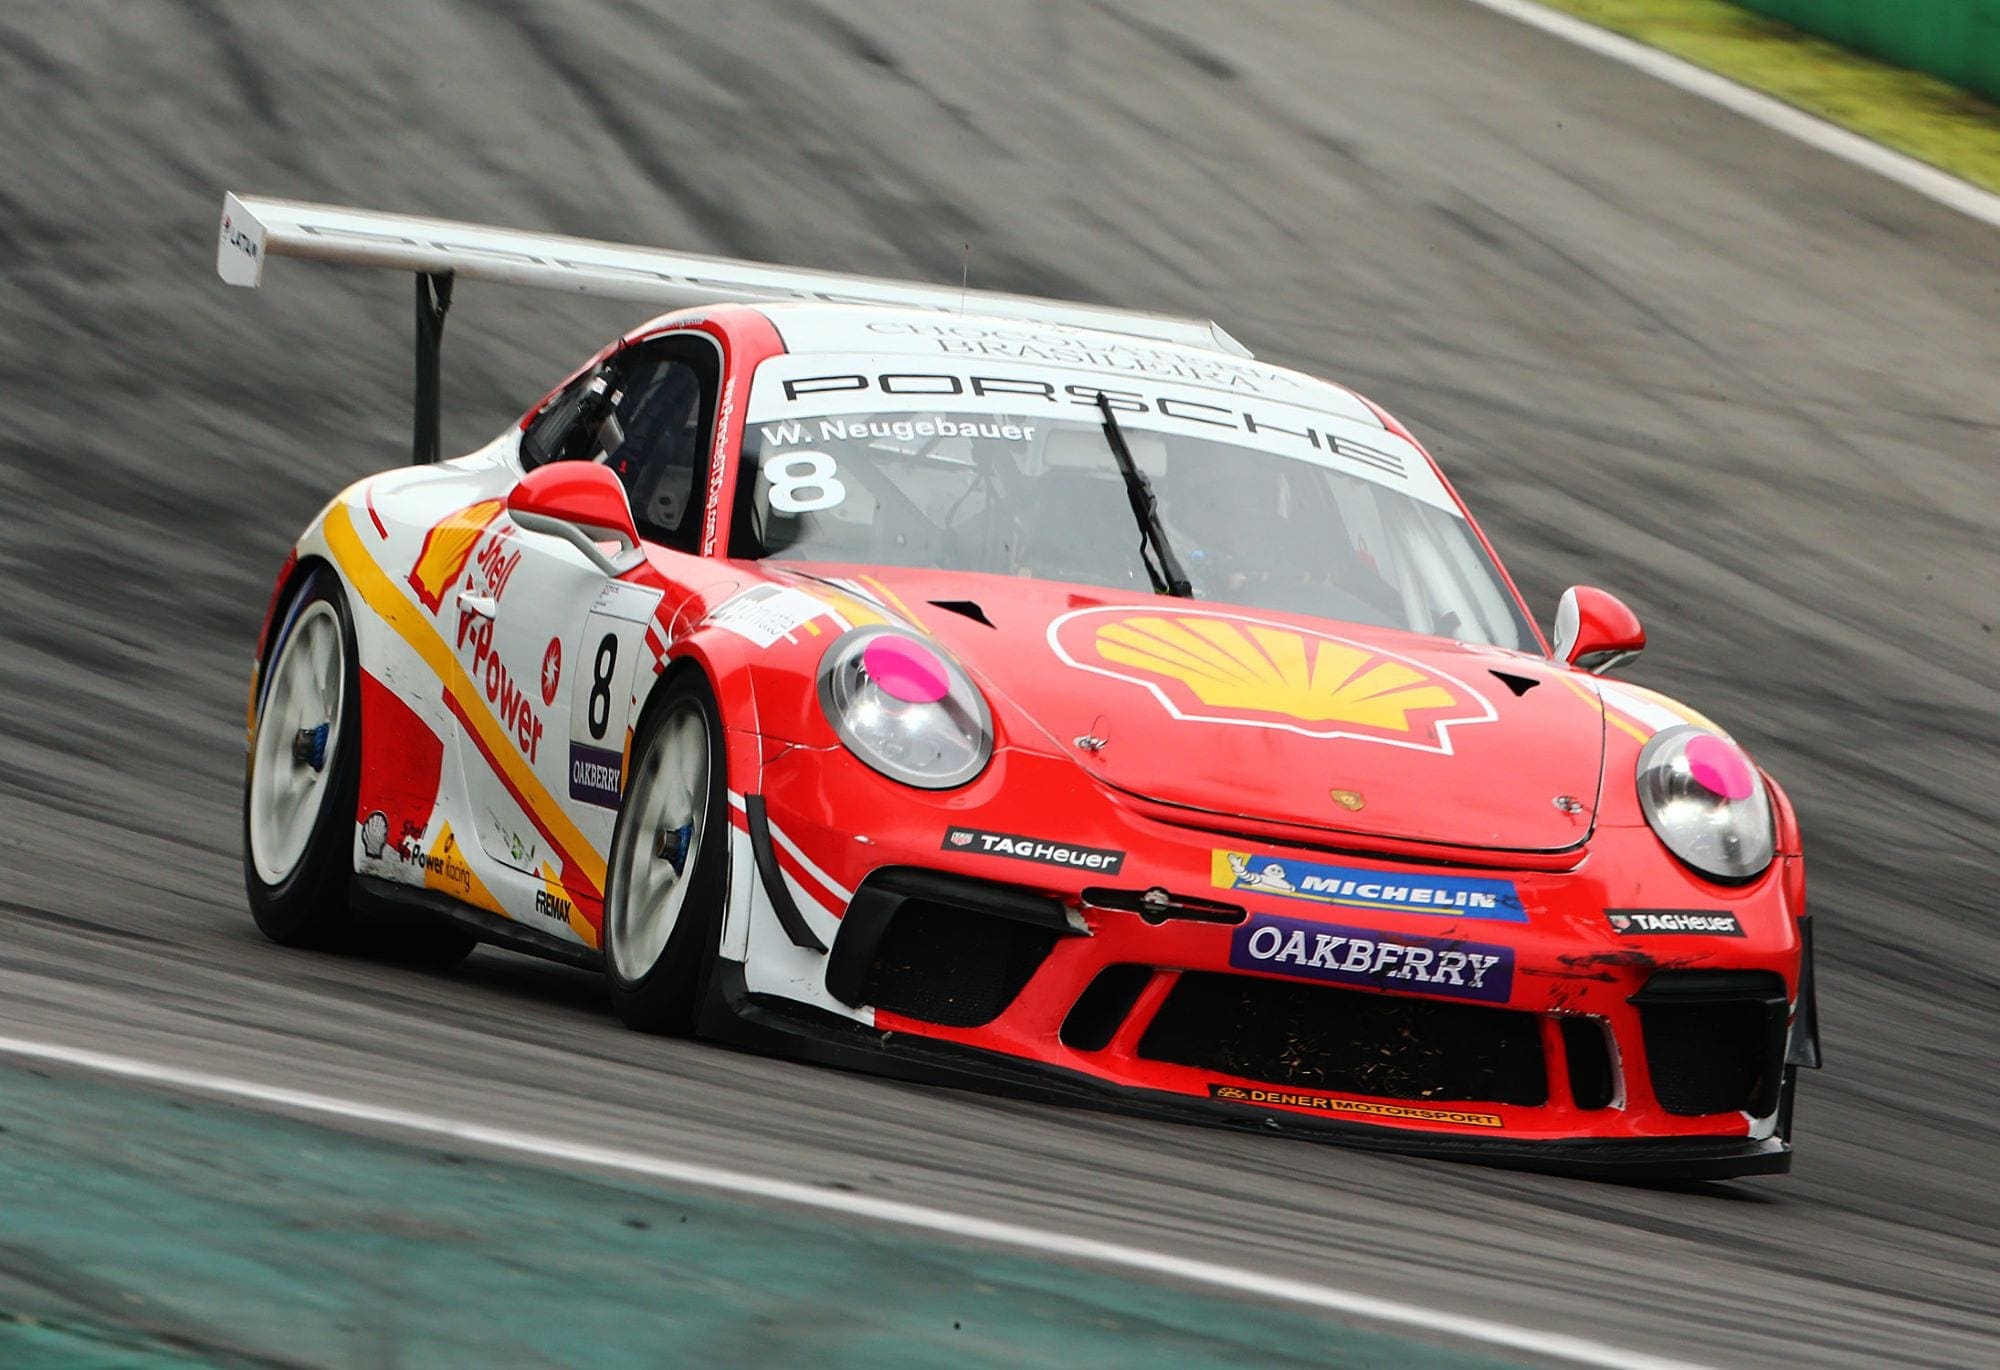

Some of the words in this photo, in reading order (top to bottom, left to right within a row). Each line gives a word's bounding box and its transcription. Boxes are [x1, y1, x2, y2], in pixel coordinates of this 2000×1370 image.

[761, 423, 812, 447] W.
[819, 417, 1036, 442] Neugebauer
[781, 372, 1408, 480] PORSCHE
[763, 450, 846, 513] 8
[477, 525, 522, 603] Shell
[588, 632, 618, 740] 8
[572, 759, 621, 793] OAKBERRY
[535, 888, 571, 924] FREMAX
[1300, 875, 1497, 909] MICHELIN
[1248, 926, 1500, 988] OAKBERRY
[1251, 1090, 1328, 1109] DENER
[1336, 1101, 1495, 1125] MOTORSPORT
